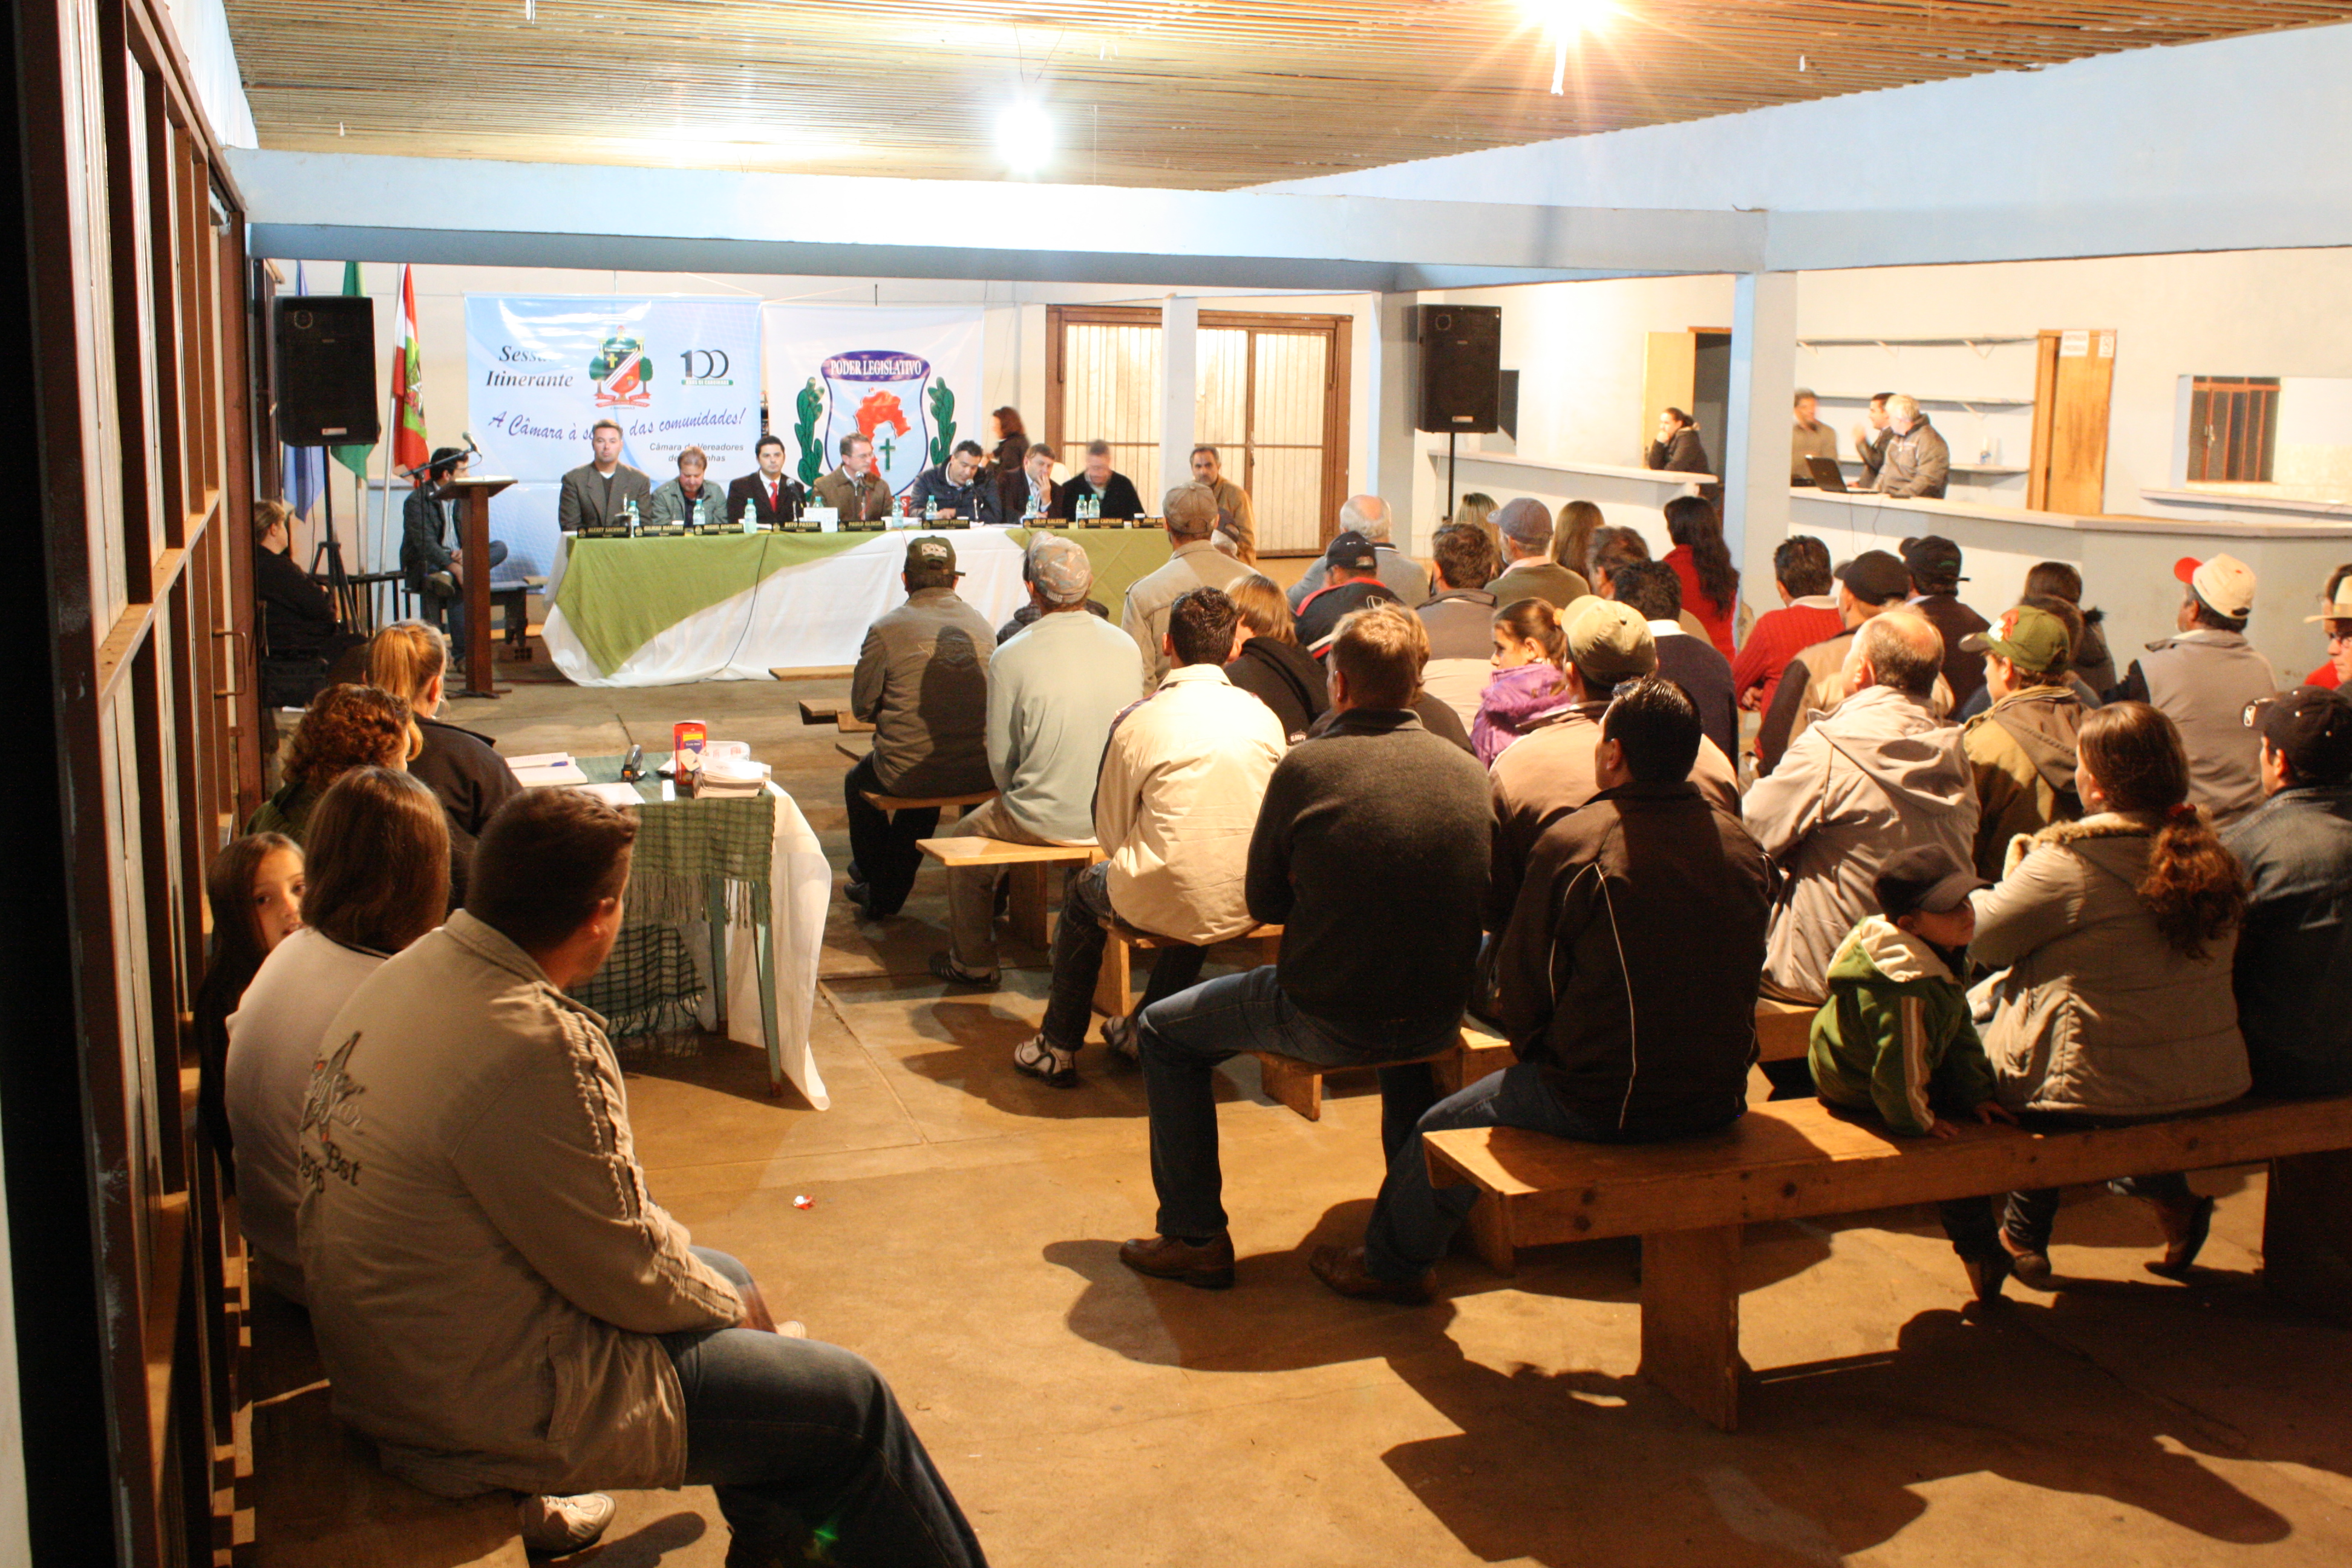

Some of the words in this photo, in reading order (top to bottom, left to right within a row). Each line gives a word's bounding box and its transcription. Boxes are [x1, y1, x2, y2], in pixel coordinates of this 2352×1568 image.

[498, 345, 556, 362] Sess
[680, 349, 729, 379] 100
[830, 360, 862, 375] PODER
[863, 359, 922, 375] LEGISLATIVO
[486, 370, 574, 387] Itinerante
[488, 410, 508, 428] A
[509, 414, 564, 440] Câmara
[629, 418, 654, 436] das
[659, 407, 747, 433] comunidades!
[649, 442, 682, 451] Câmara
[697, 442, 744, 451] Vereadores
